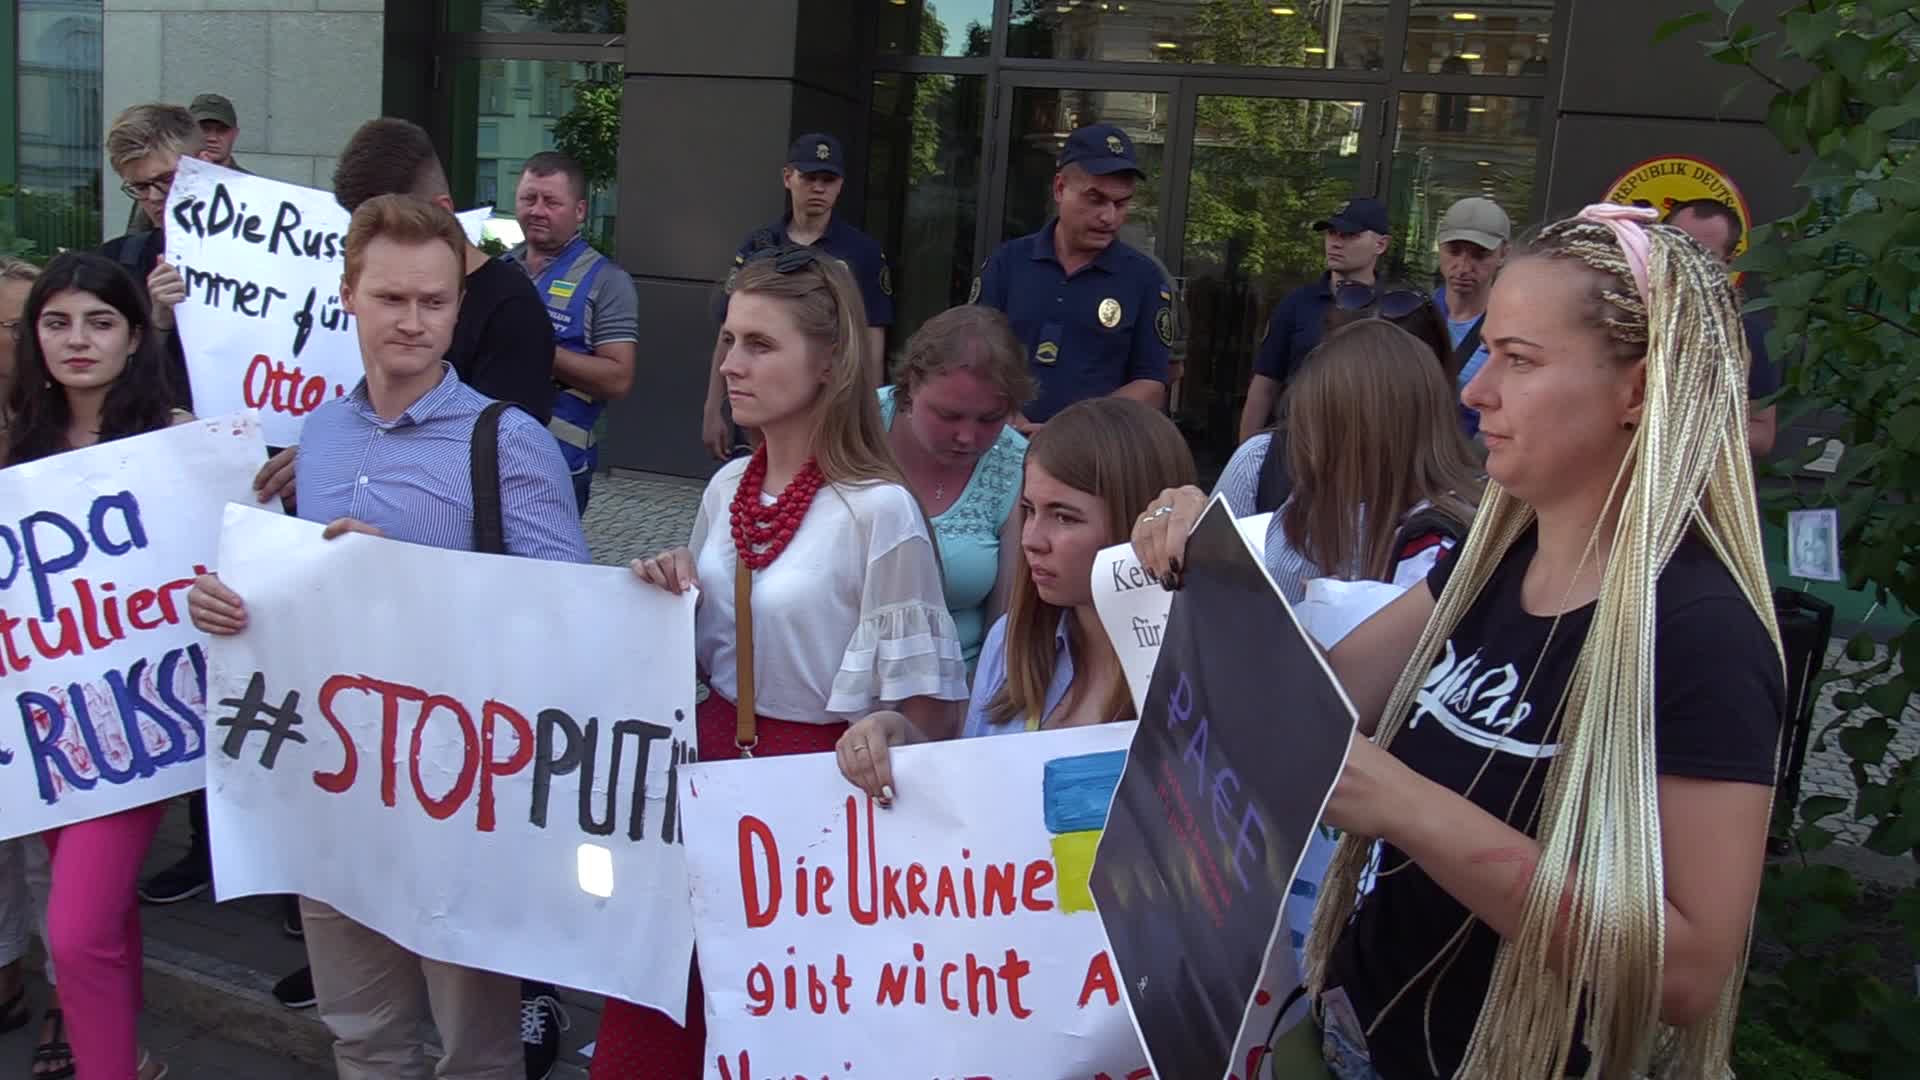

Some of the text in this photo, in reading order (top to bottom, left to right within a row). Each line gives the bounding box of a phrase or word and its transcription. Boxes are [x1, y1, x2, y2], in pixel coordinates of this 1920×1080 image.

[1611, 162, 1735, 206] REPUBLIK DEUTS
[242, 353, 327, 417] Otto
[0, 564, 208, 678] tulier
[738, 814, 835, 929] Die
[745, 945, 853, 1018] gibt
[1076, 950, 1120, 1008] A
